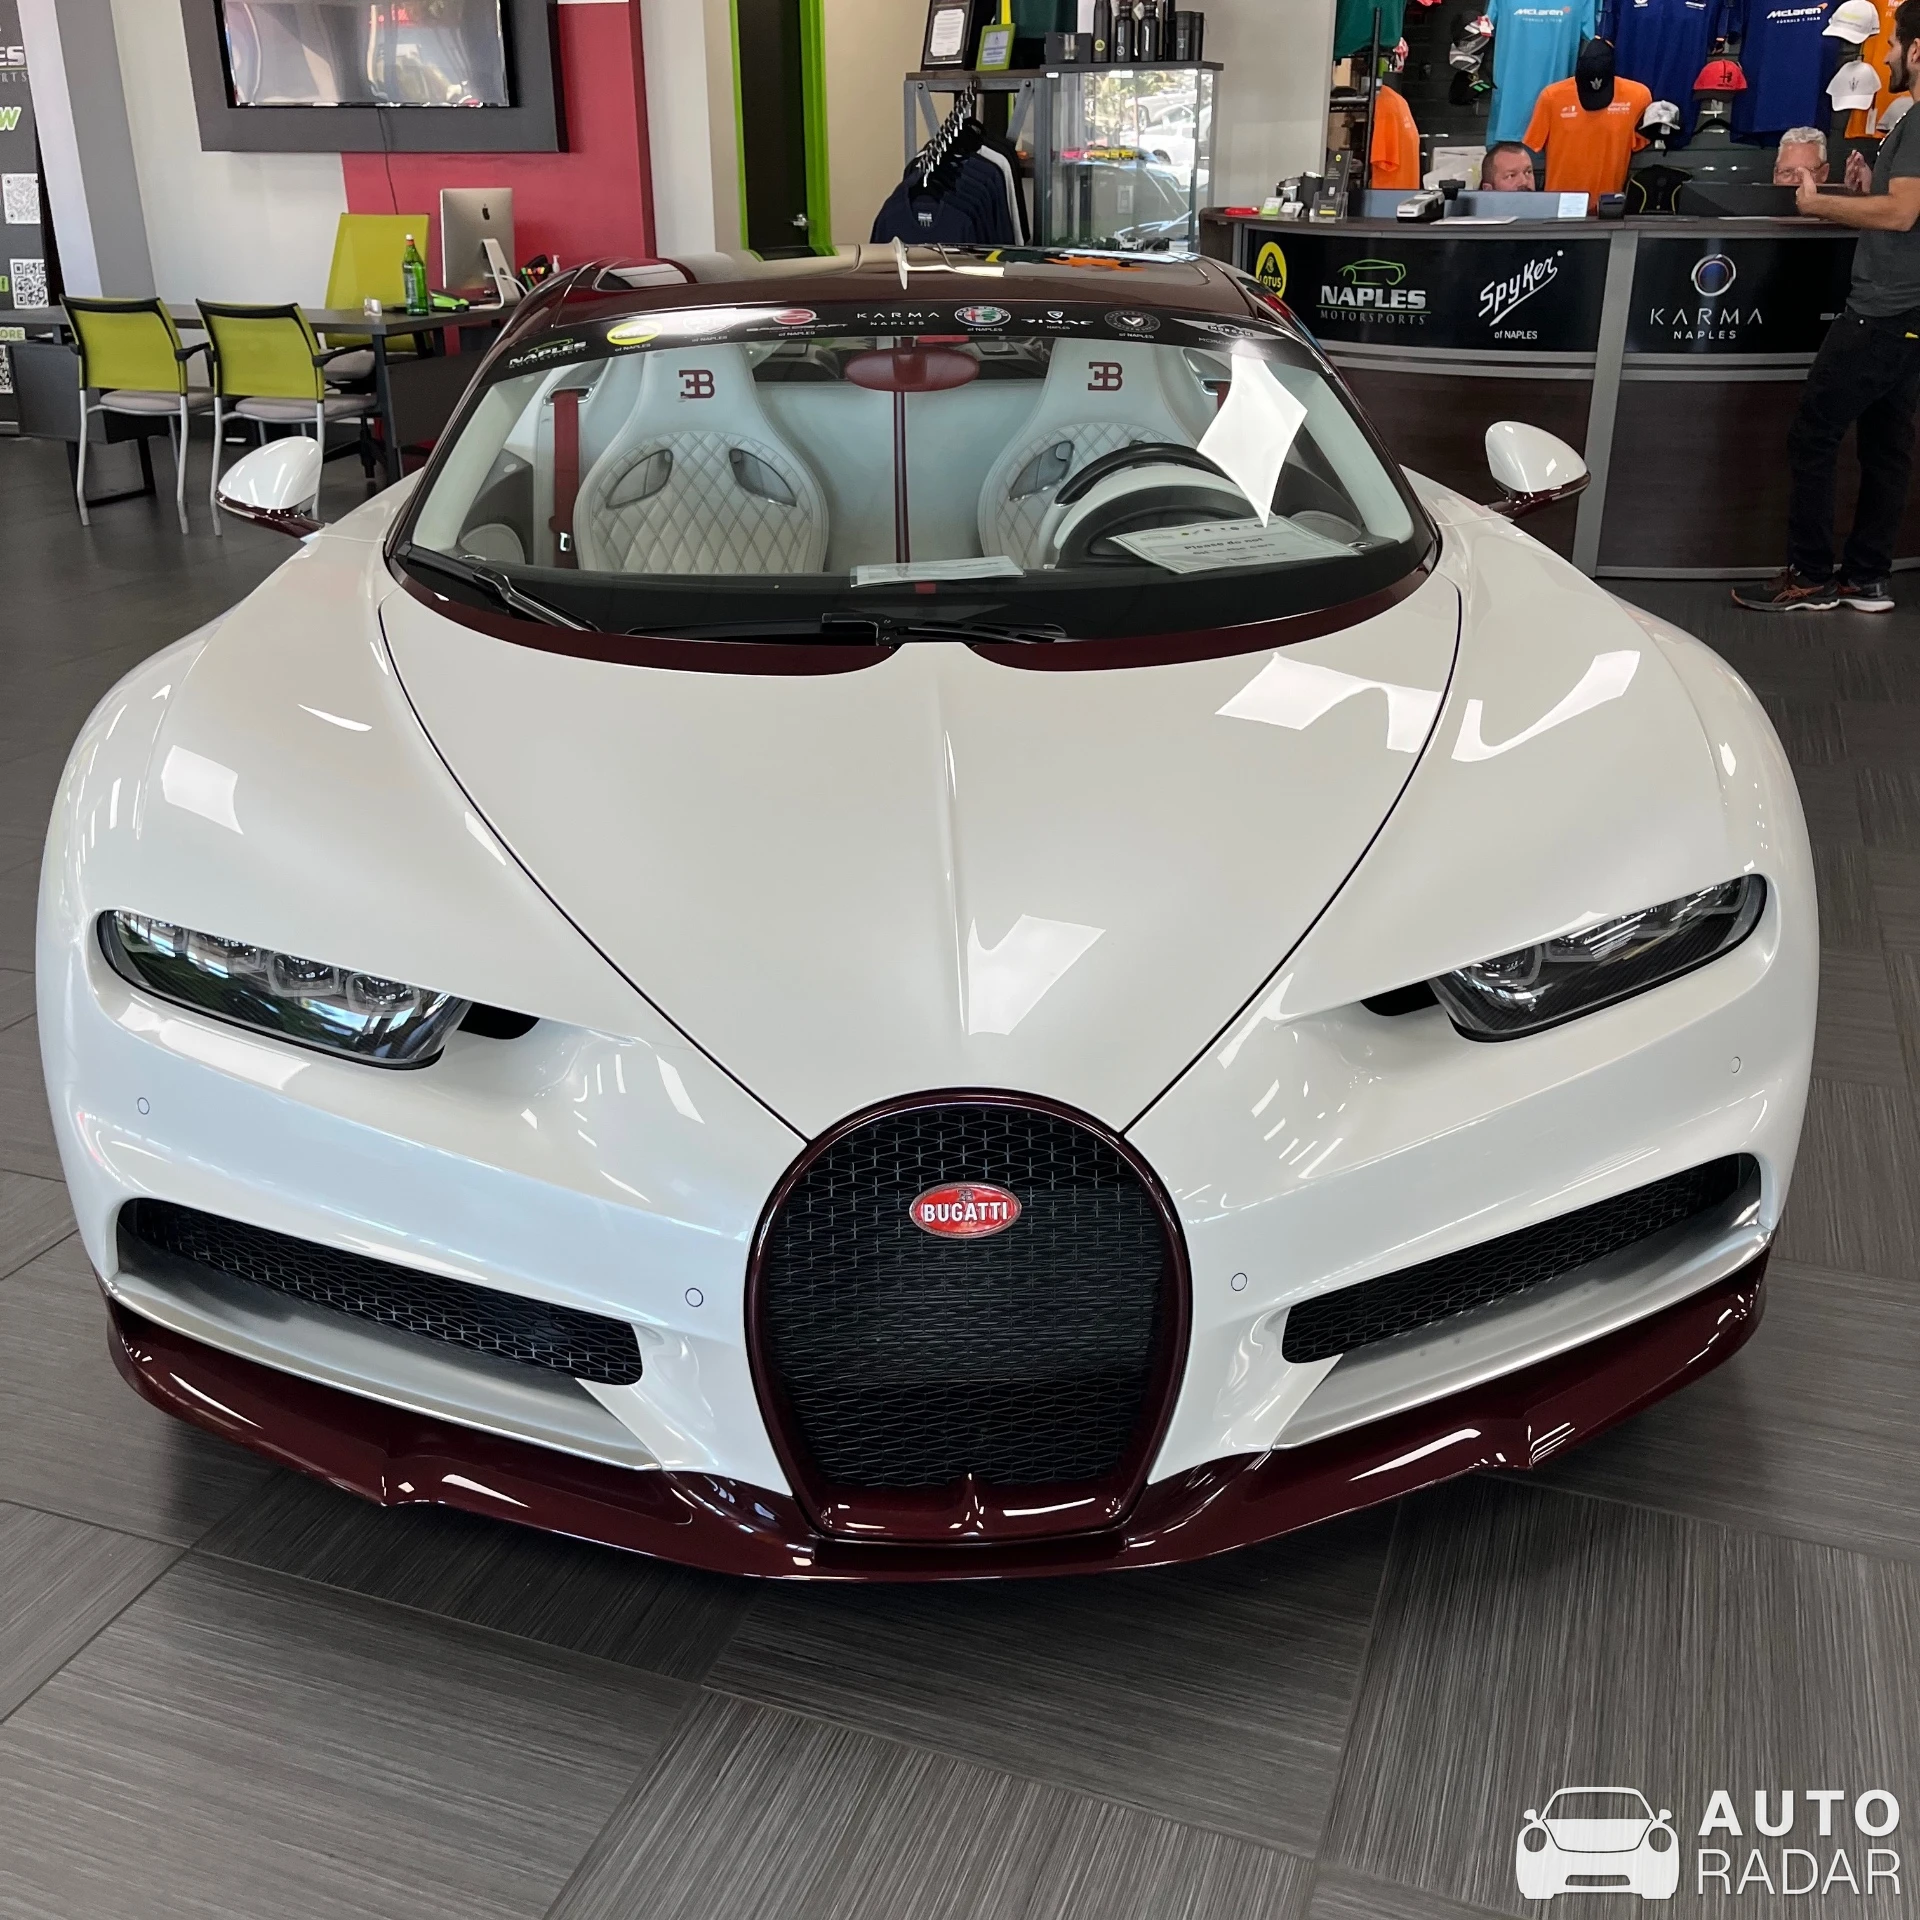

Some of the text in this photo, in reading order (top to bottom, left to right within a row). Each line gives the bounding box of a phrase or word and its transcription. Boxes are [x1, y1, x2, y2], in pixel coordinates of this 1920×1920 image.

[1259, 275, 1282, 288] LOTUS
[1320, 285, 1427, 310] NAPLES
[1320, 310, 1425, 326] MOTORSPORTS
[1650, 308, 1763, 325] KARMA
[1494, 330, 1538, 340] of NAPLES
[1673, 330, 1737, 340] NAPLES
[509, 341, 587, 366] NAPLES
[1184, 542, 1225, 550] Please
[923, 1201, 1008, 1223] BUGATTI
